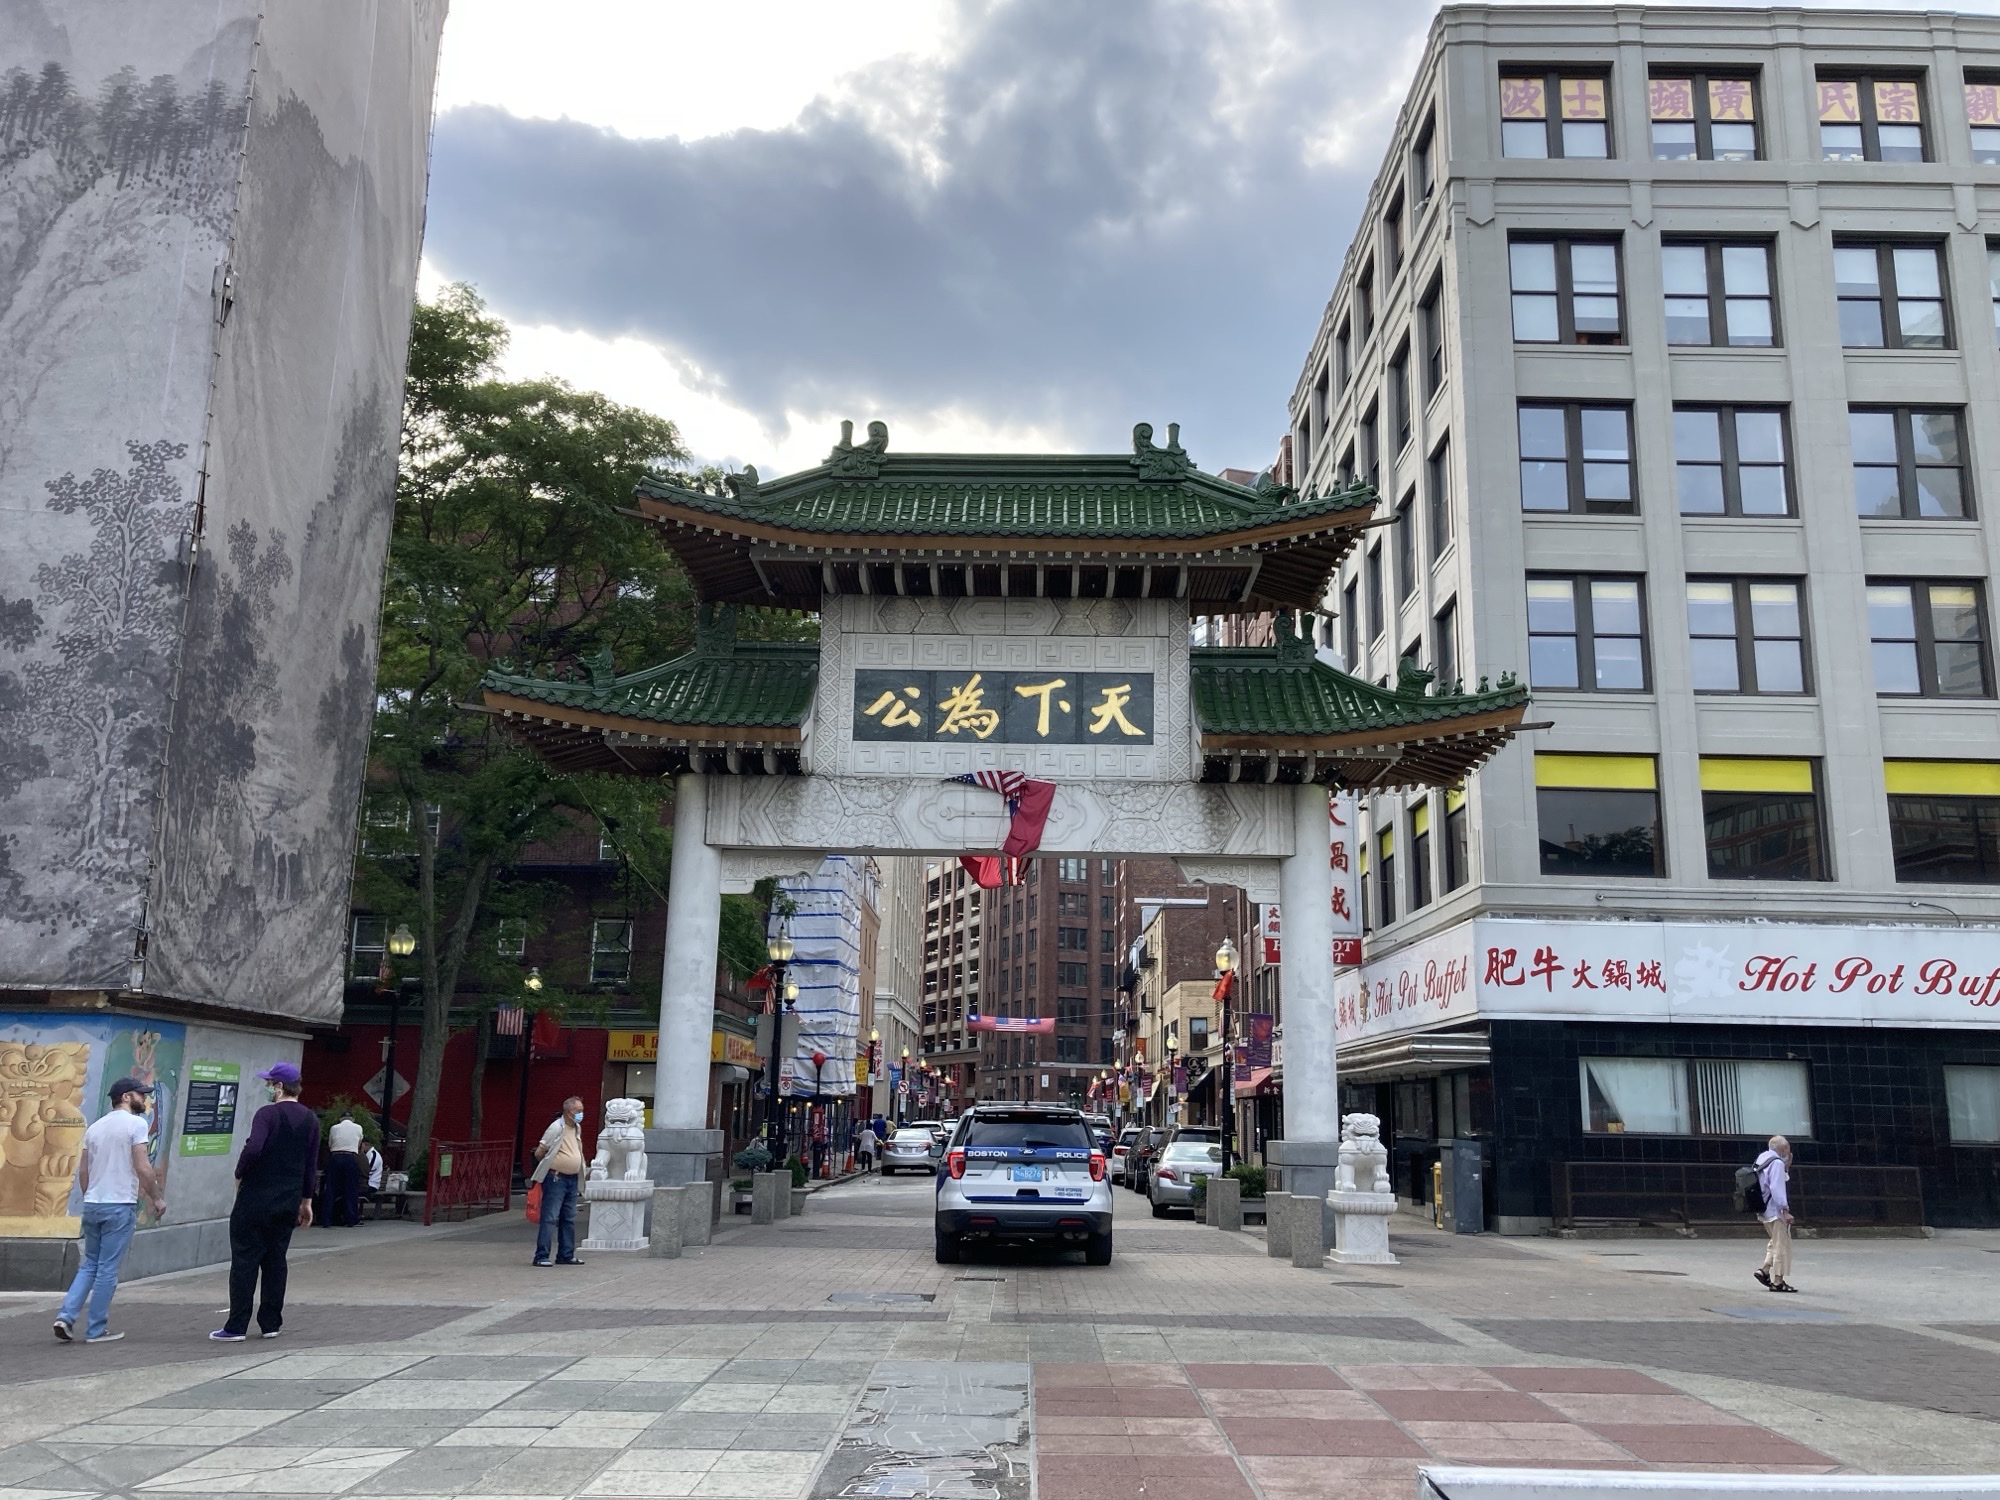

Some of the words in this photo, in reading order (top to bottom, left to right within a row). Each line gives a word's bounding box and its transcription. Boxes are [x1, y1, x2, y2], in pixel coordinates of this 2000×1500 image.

[1374, 977, 1393, 1018] Hot
[1398, 970, 1418, 1011] Pot
[1423, 955, 1468, 1010] Buffet
[1484, 944, 1667, 993] 肥牛火鍋城
[1738, 955, 1818, 993] Hot
[1828, 956, 1905, 994] Pot
[613, 1049, 639, 1058] HING
[642, 1050, 657, 1058] SH
[967, 1150, 1008, 1158] BOSTON
[1056, 1151, 1088, 1159] POLICE
